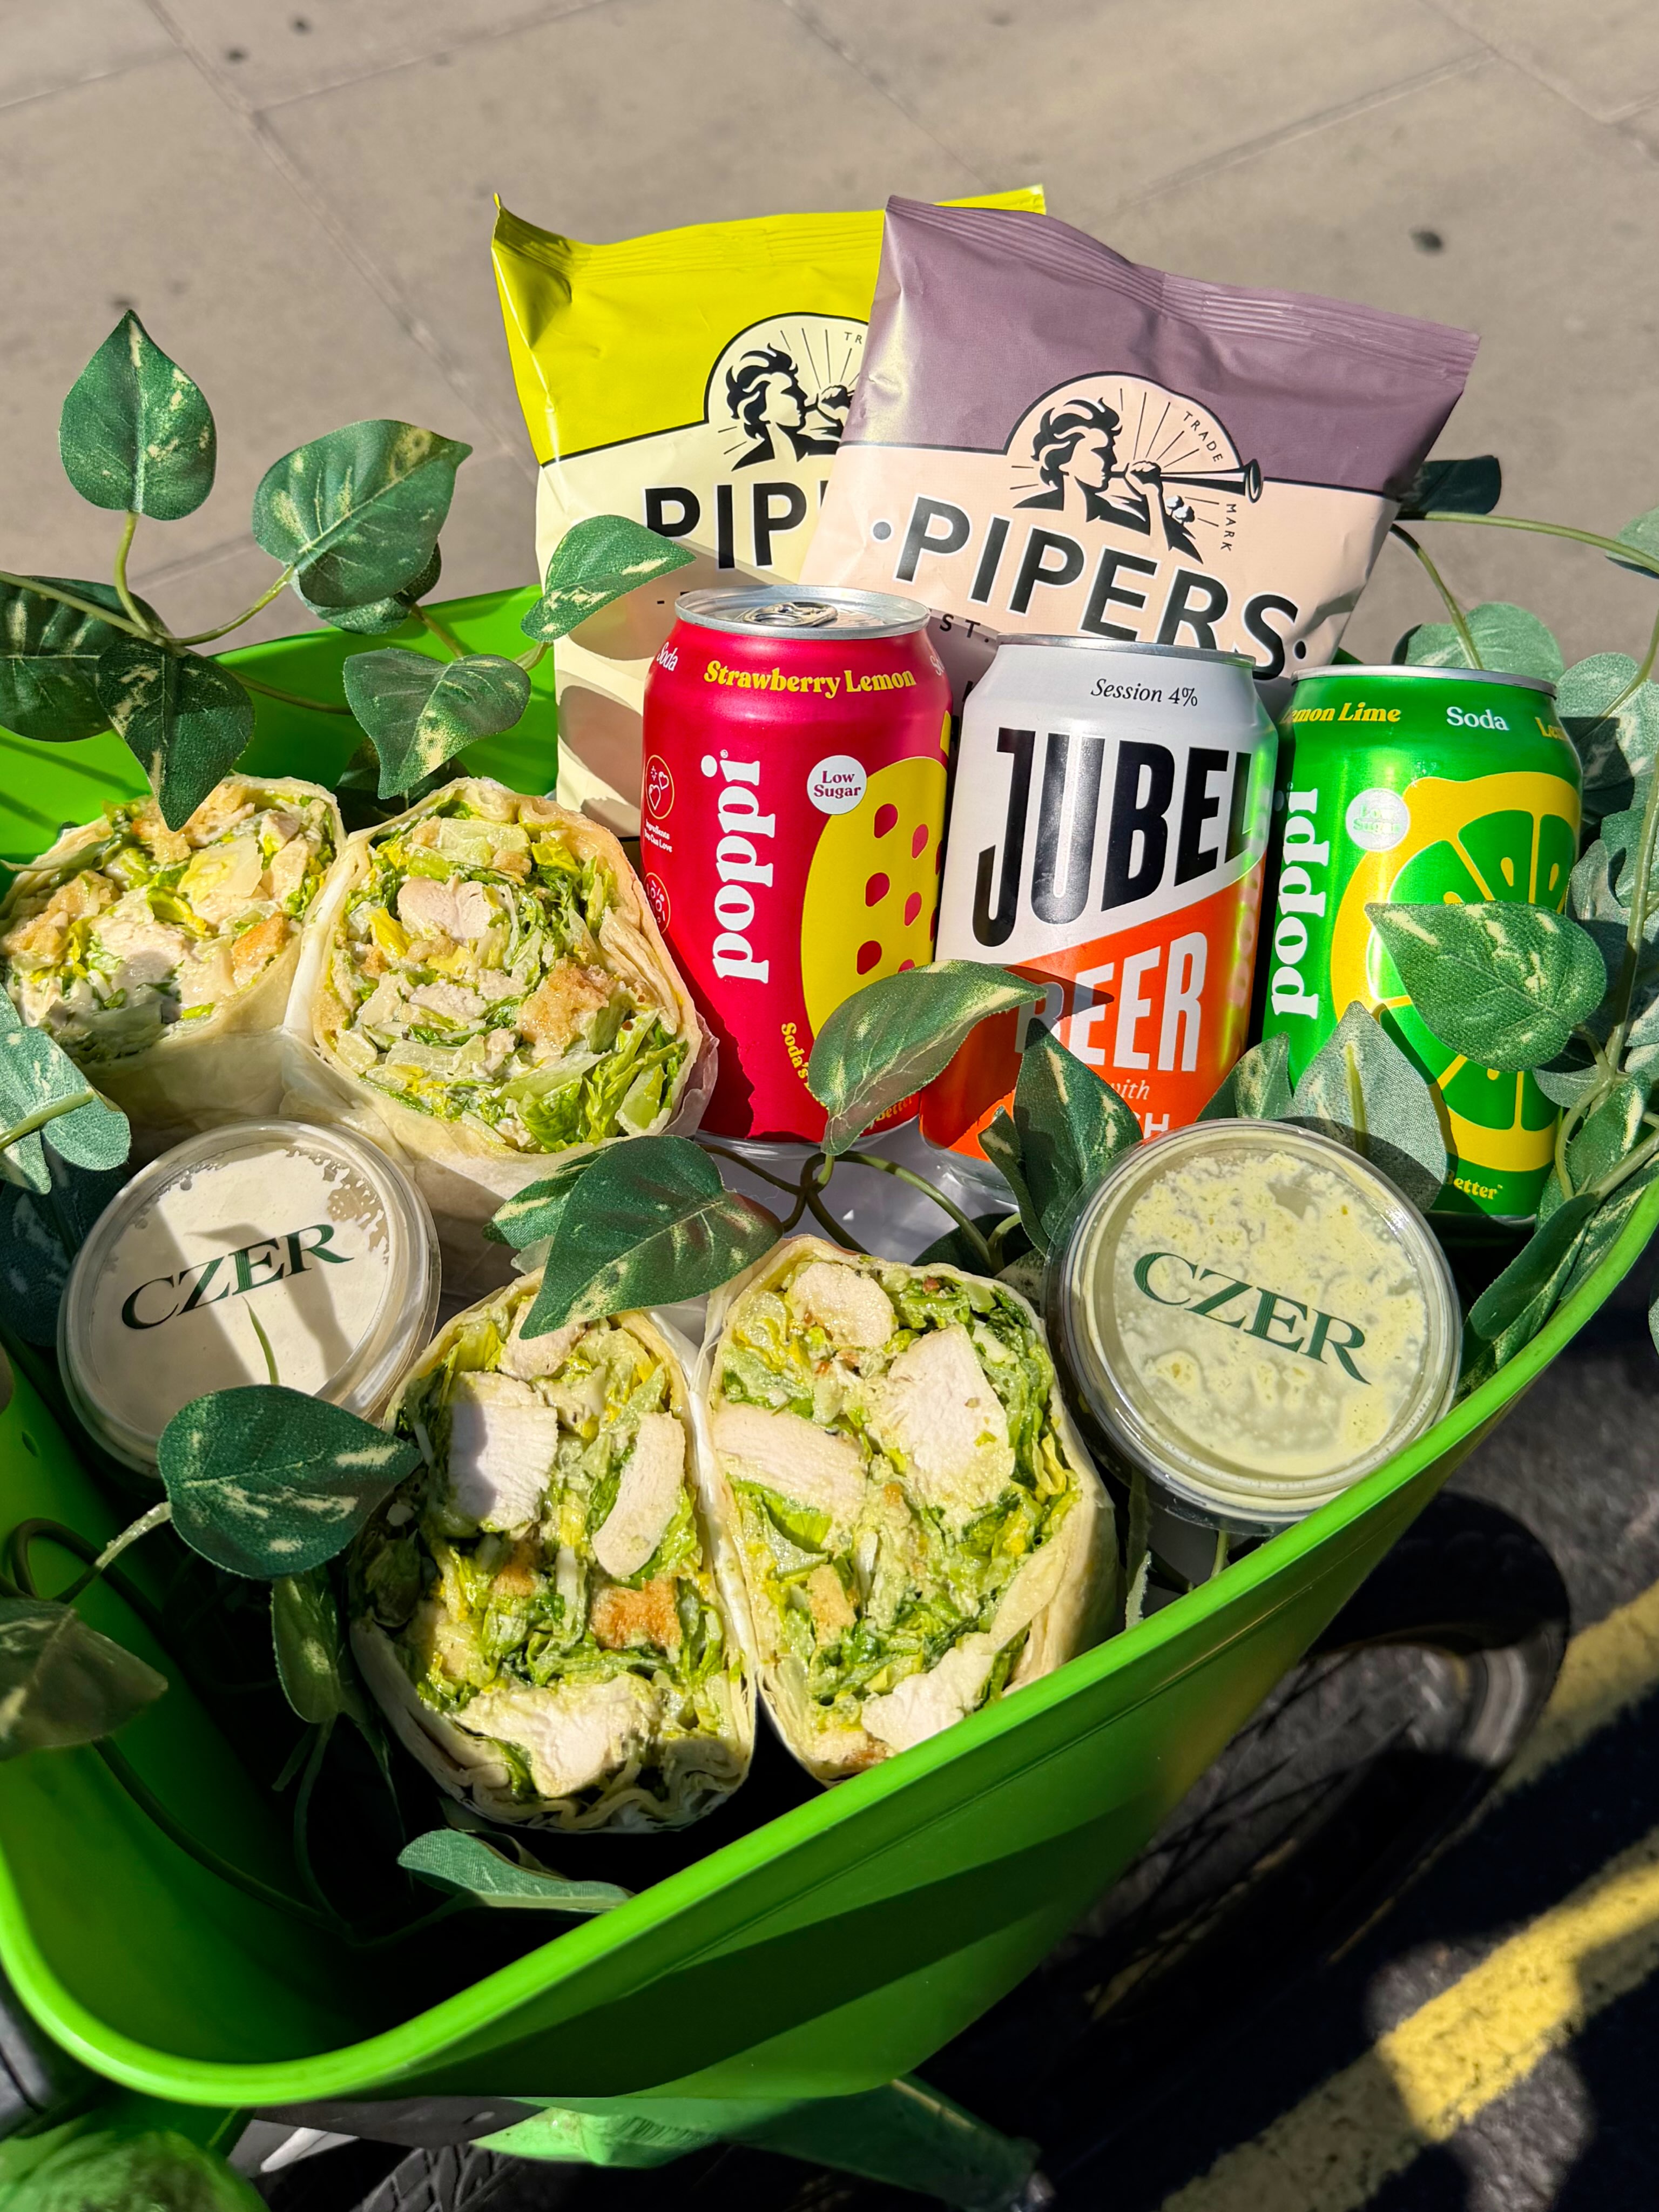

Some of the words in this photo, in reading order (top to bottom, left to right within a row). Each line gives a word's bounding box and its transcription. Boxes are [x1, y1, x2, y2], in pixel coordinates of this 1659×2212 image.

[1183, 410, 1224, 463] TRADE
[645, 480, 828, 569] PIP
[1220, 503, 1237, 552] MARK
[894, 496, 1298, 680] PIPERS
[929, 609, 989, 643] ST.
[656, 641, 678, 672] Soda
[704, 660, 841, 699] Strawberry
[843, 669, 917, 693] Lemon
[1090, 678, 1162, 703] Session
[1168, 687, 1198, 707] 4%
[1338, 702, 1402, 723] Lime
[1446, 706, 1510, 731] Soda
[813, 784, 862, 799] Sugar
[821, 770, 855, 784] Low
[972, 727, 1253, 946] JUBEL
[701, 754, 776, 984] poppi
[1271, 788, 1330, 1020] poppi
[122, 1224, 354, 1330] CZER
[1133, 1252, 1372, 1386] CZER
